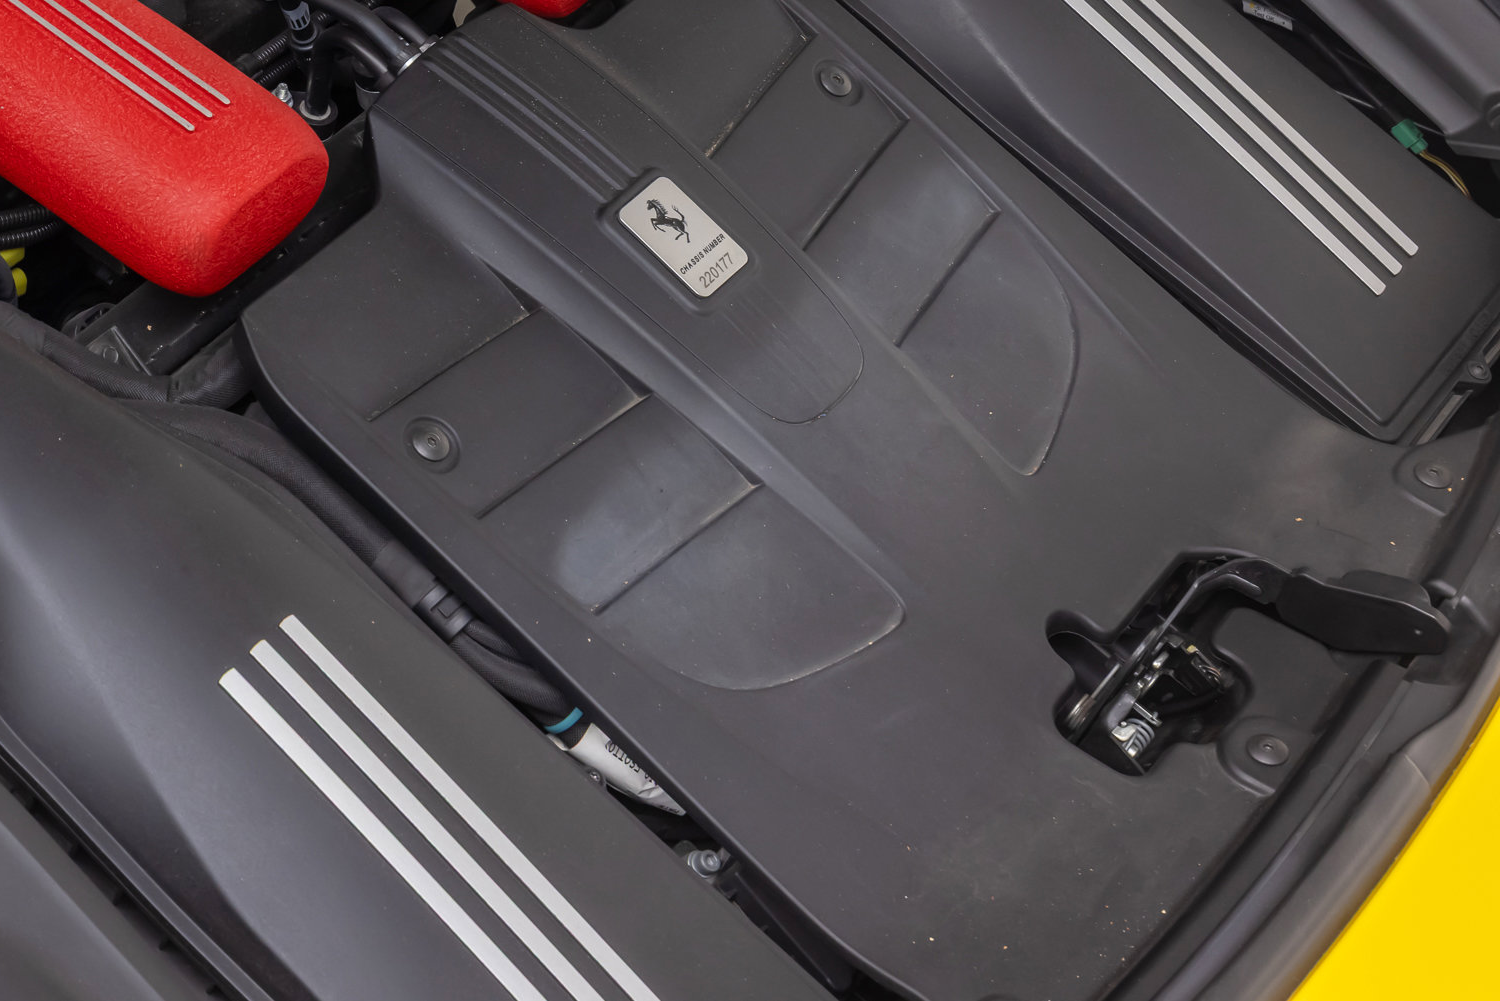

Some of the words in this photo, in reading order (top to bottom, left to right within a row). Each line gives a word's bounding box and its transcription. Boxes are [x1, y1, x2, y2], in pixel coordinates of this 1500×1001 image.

[680, 251, 705, 275] CHASSIS
[703, 233, 726, 255] NUMBER
[699, 252, 733, 288] 220177
